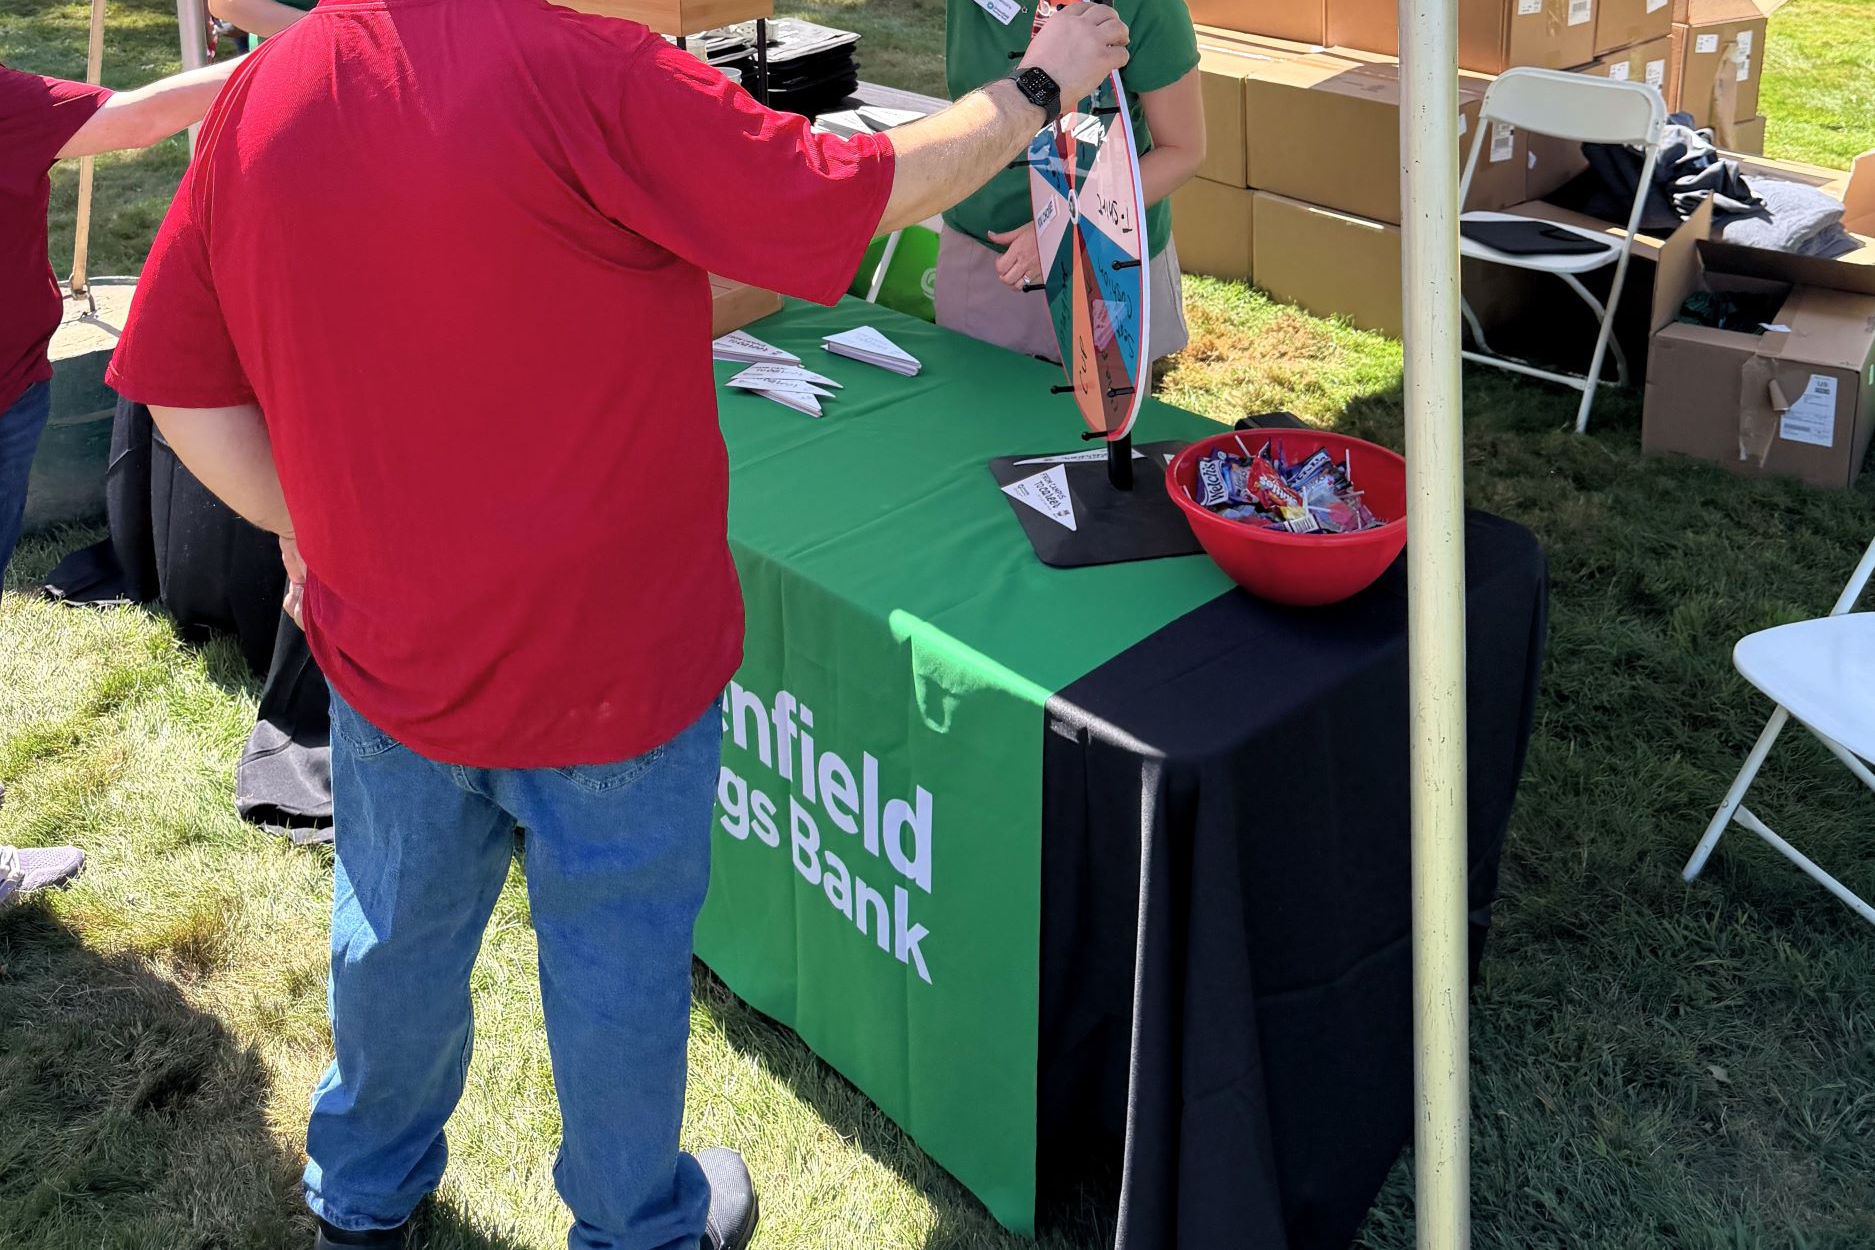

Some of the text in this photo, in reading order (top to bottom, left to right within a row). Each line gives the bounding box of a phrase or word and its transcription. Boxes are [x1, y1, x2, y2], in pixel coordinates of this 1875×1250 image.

[1040, 472, 1051, 487] FROM
[1048, 482, 1066, 500] CAMPUS
[1202, 463, 1225, 502] Welch's
[721, 679, 932, 894] nfield
[790, 794, 932, 985] Bank
